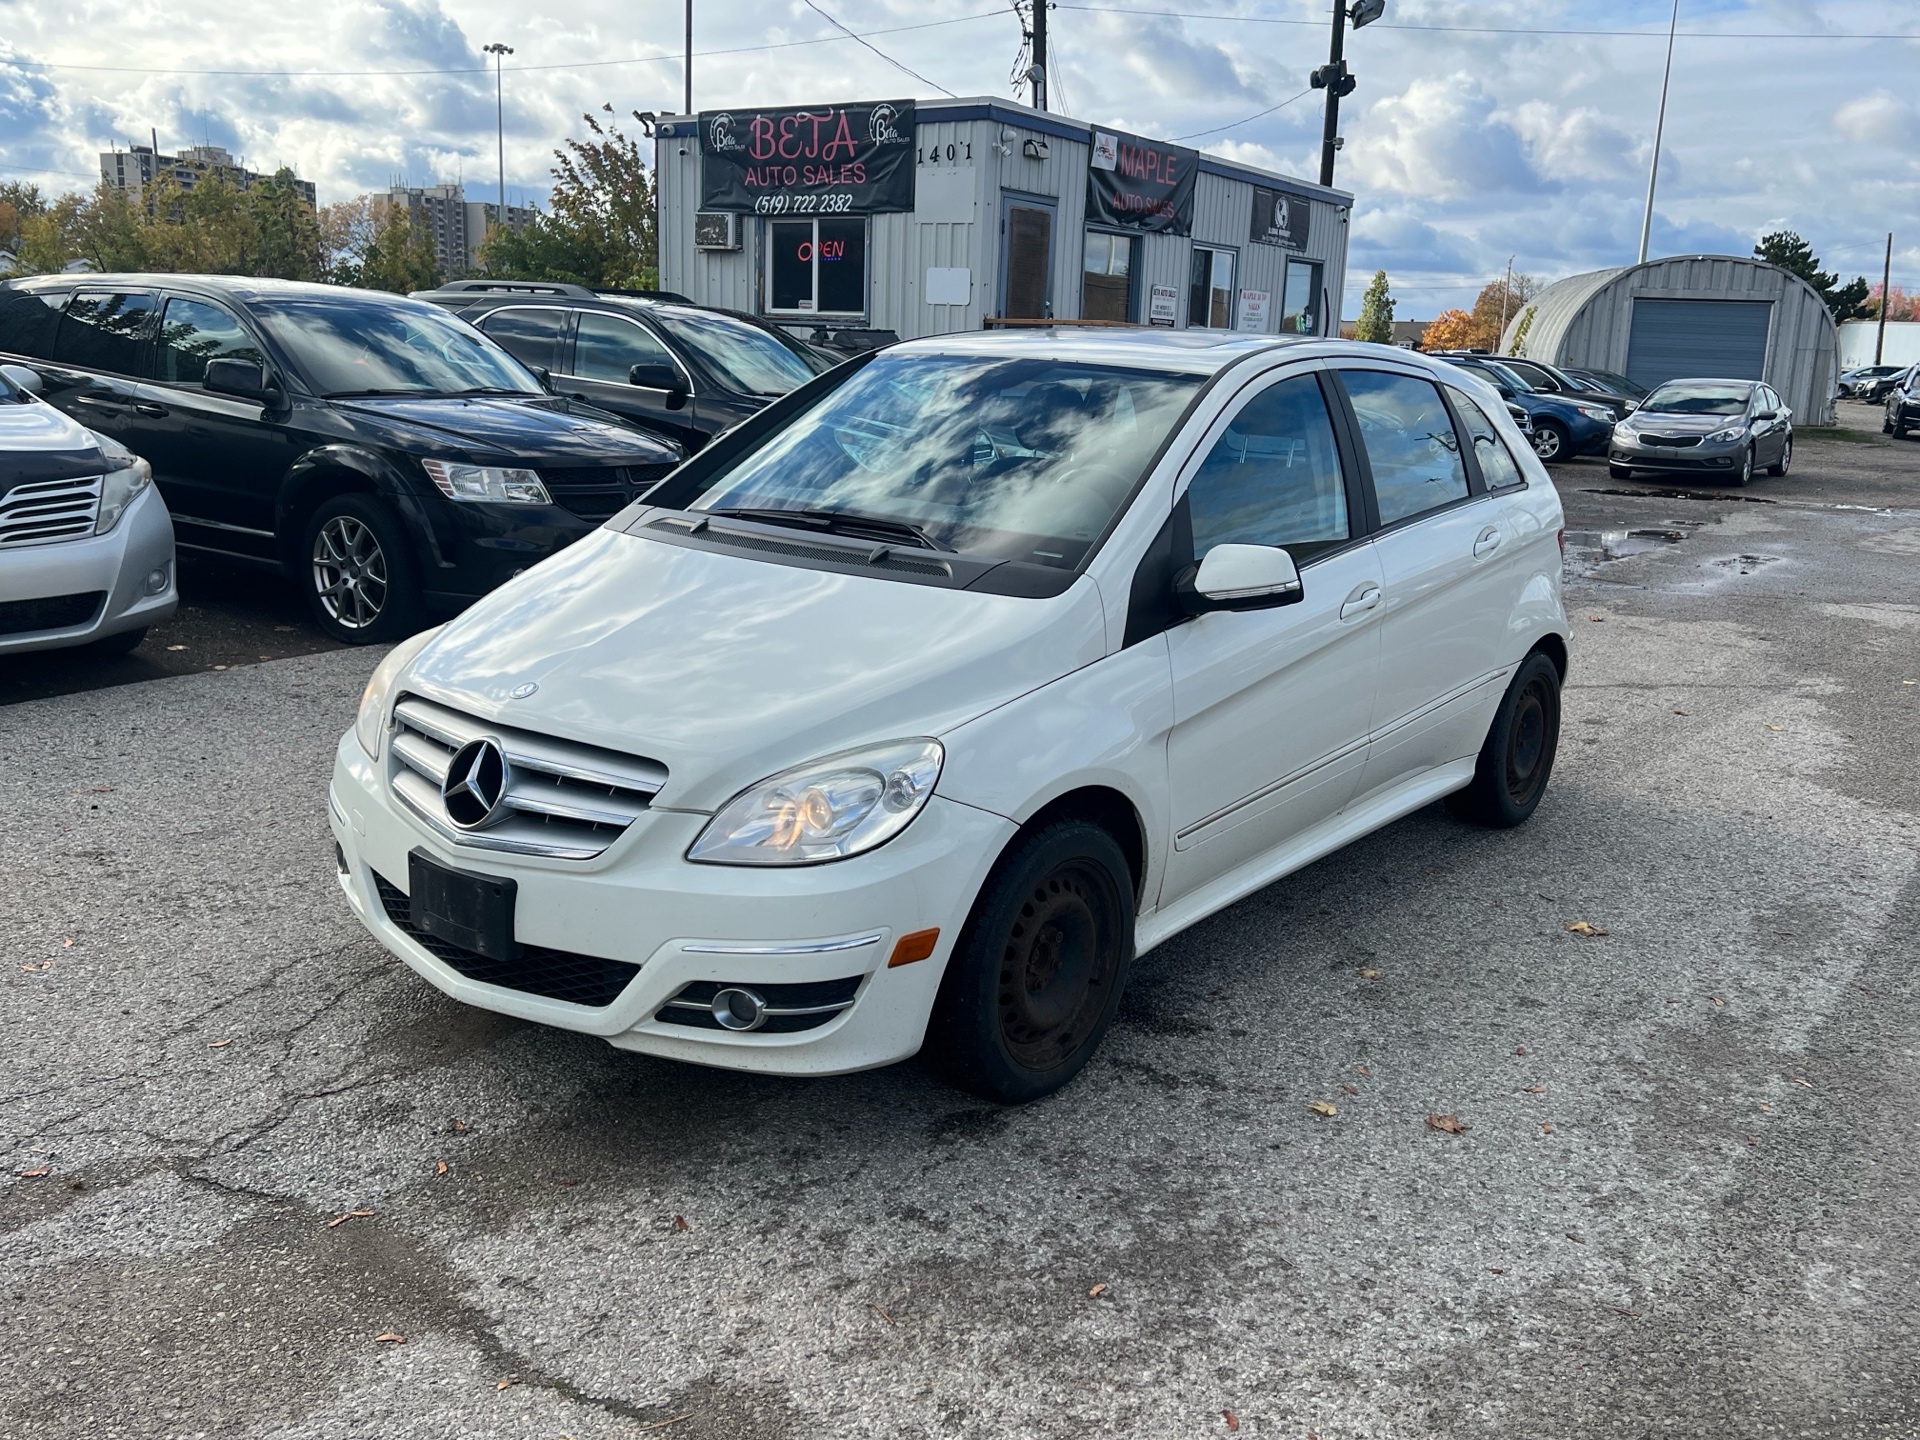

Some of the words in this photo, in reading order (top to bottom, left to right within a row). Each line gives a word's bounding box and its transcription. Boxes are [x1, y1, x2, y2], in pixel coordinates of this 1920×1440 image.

[749, 108, 858, 161] BETA
[917, 143, 972, 164] 1401
[1120, 144, 1177, 185] MAPLE
[744, 166, 797, 186] AUTO
[803, 163, 866, 185] SALES
[755, 195, 789, 215] (519)
[793, 195, 817, 213] 722
[819, 194, 853, 212] 2382
[1113, 192, 1143, 212] AUTO
[1145, 197, 1175, 219] SALES
